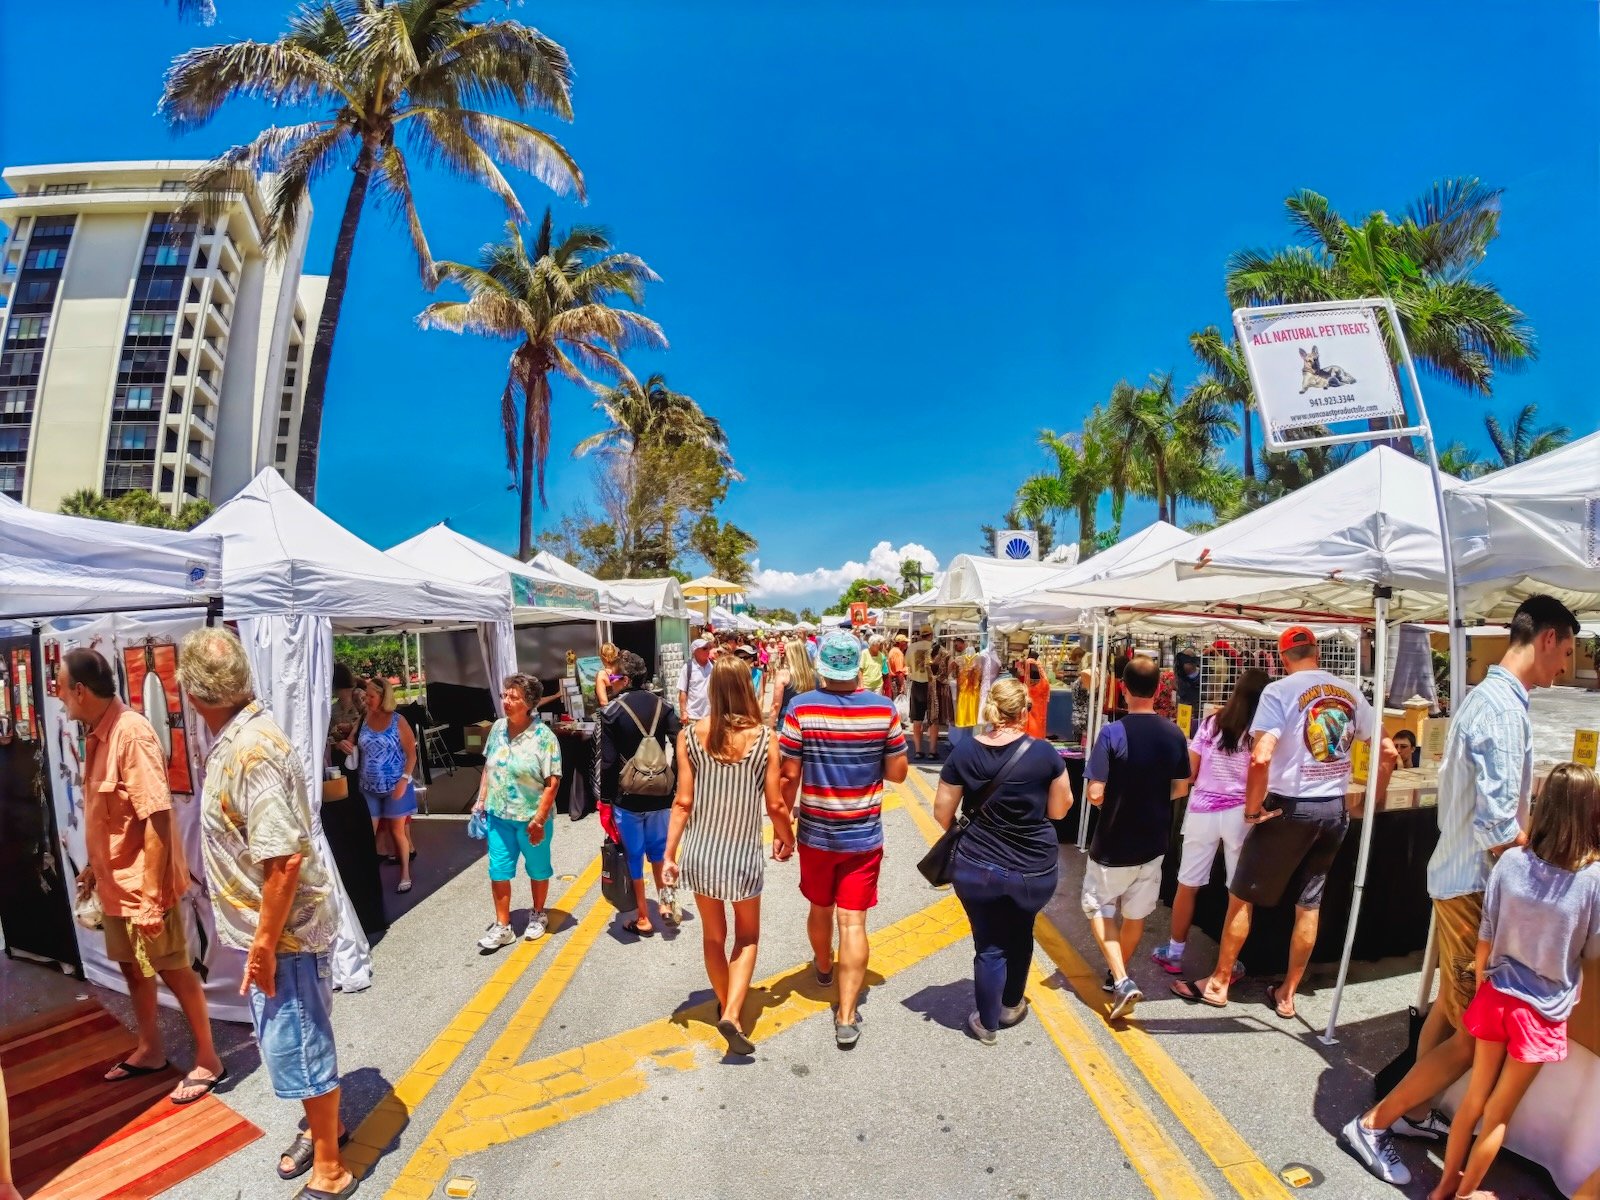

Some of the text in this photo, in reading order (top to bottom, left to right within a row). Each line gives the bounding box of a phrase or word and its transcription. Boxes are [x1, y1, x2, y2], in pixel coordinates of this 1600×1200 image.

[1253, 323, 1370, 346] ALL NATURAL PET TREATS
[1309, 394, 1355, 407] 941.923.3344
[1290, 405, 1378, 421] www.suncoastproductsllc.com
